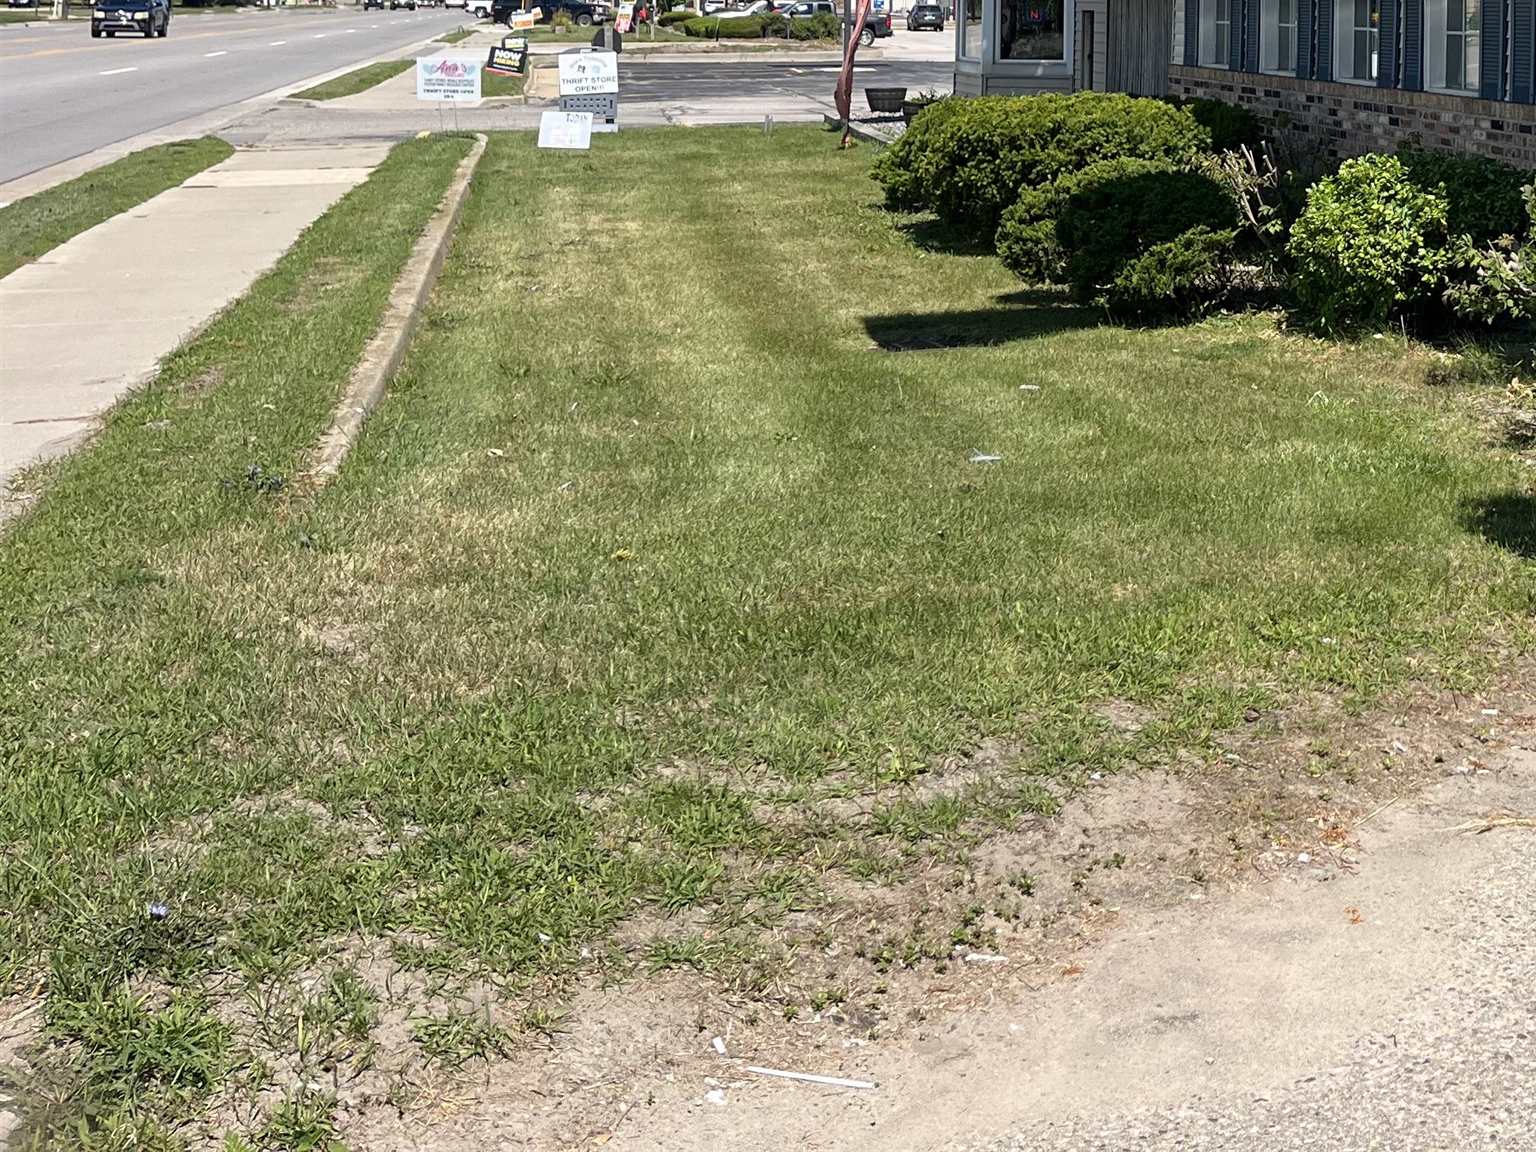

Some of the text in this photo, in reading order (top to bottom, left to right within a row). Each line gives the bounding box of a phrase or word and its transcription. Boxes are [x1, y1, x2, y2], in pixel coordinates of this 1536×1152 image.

[494, 48, 522, 61] NOW
[561, 75, 617, 86] THRIFT STORE
